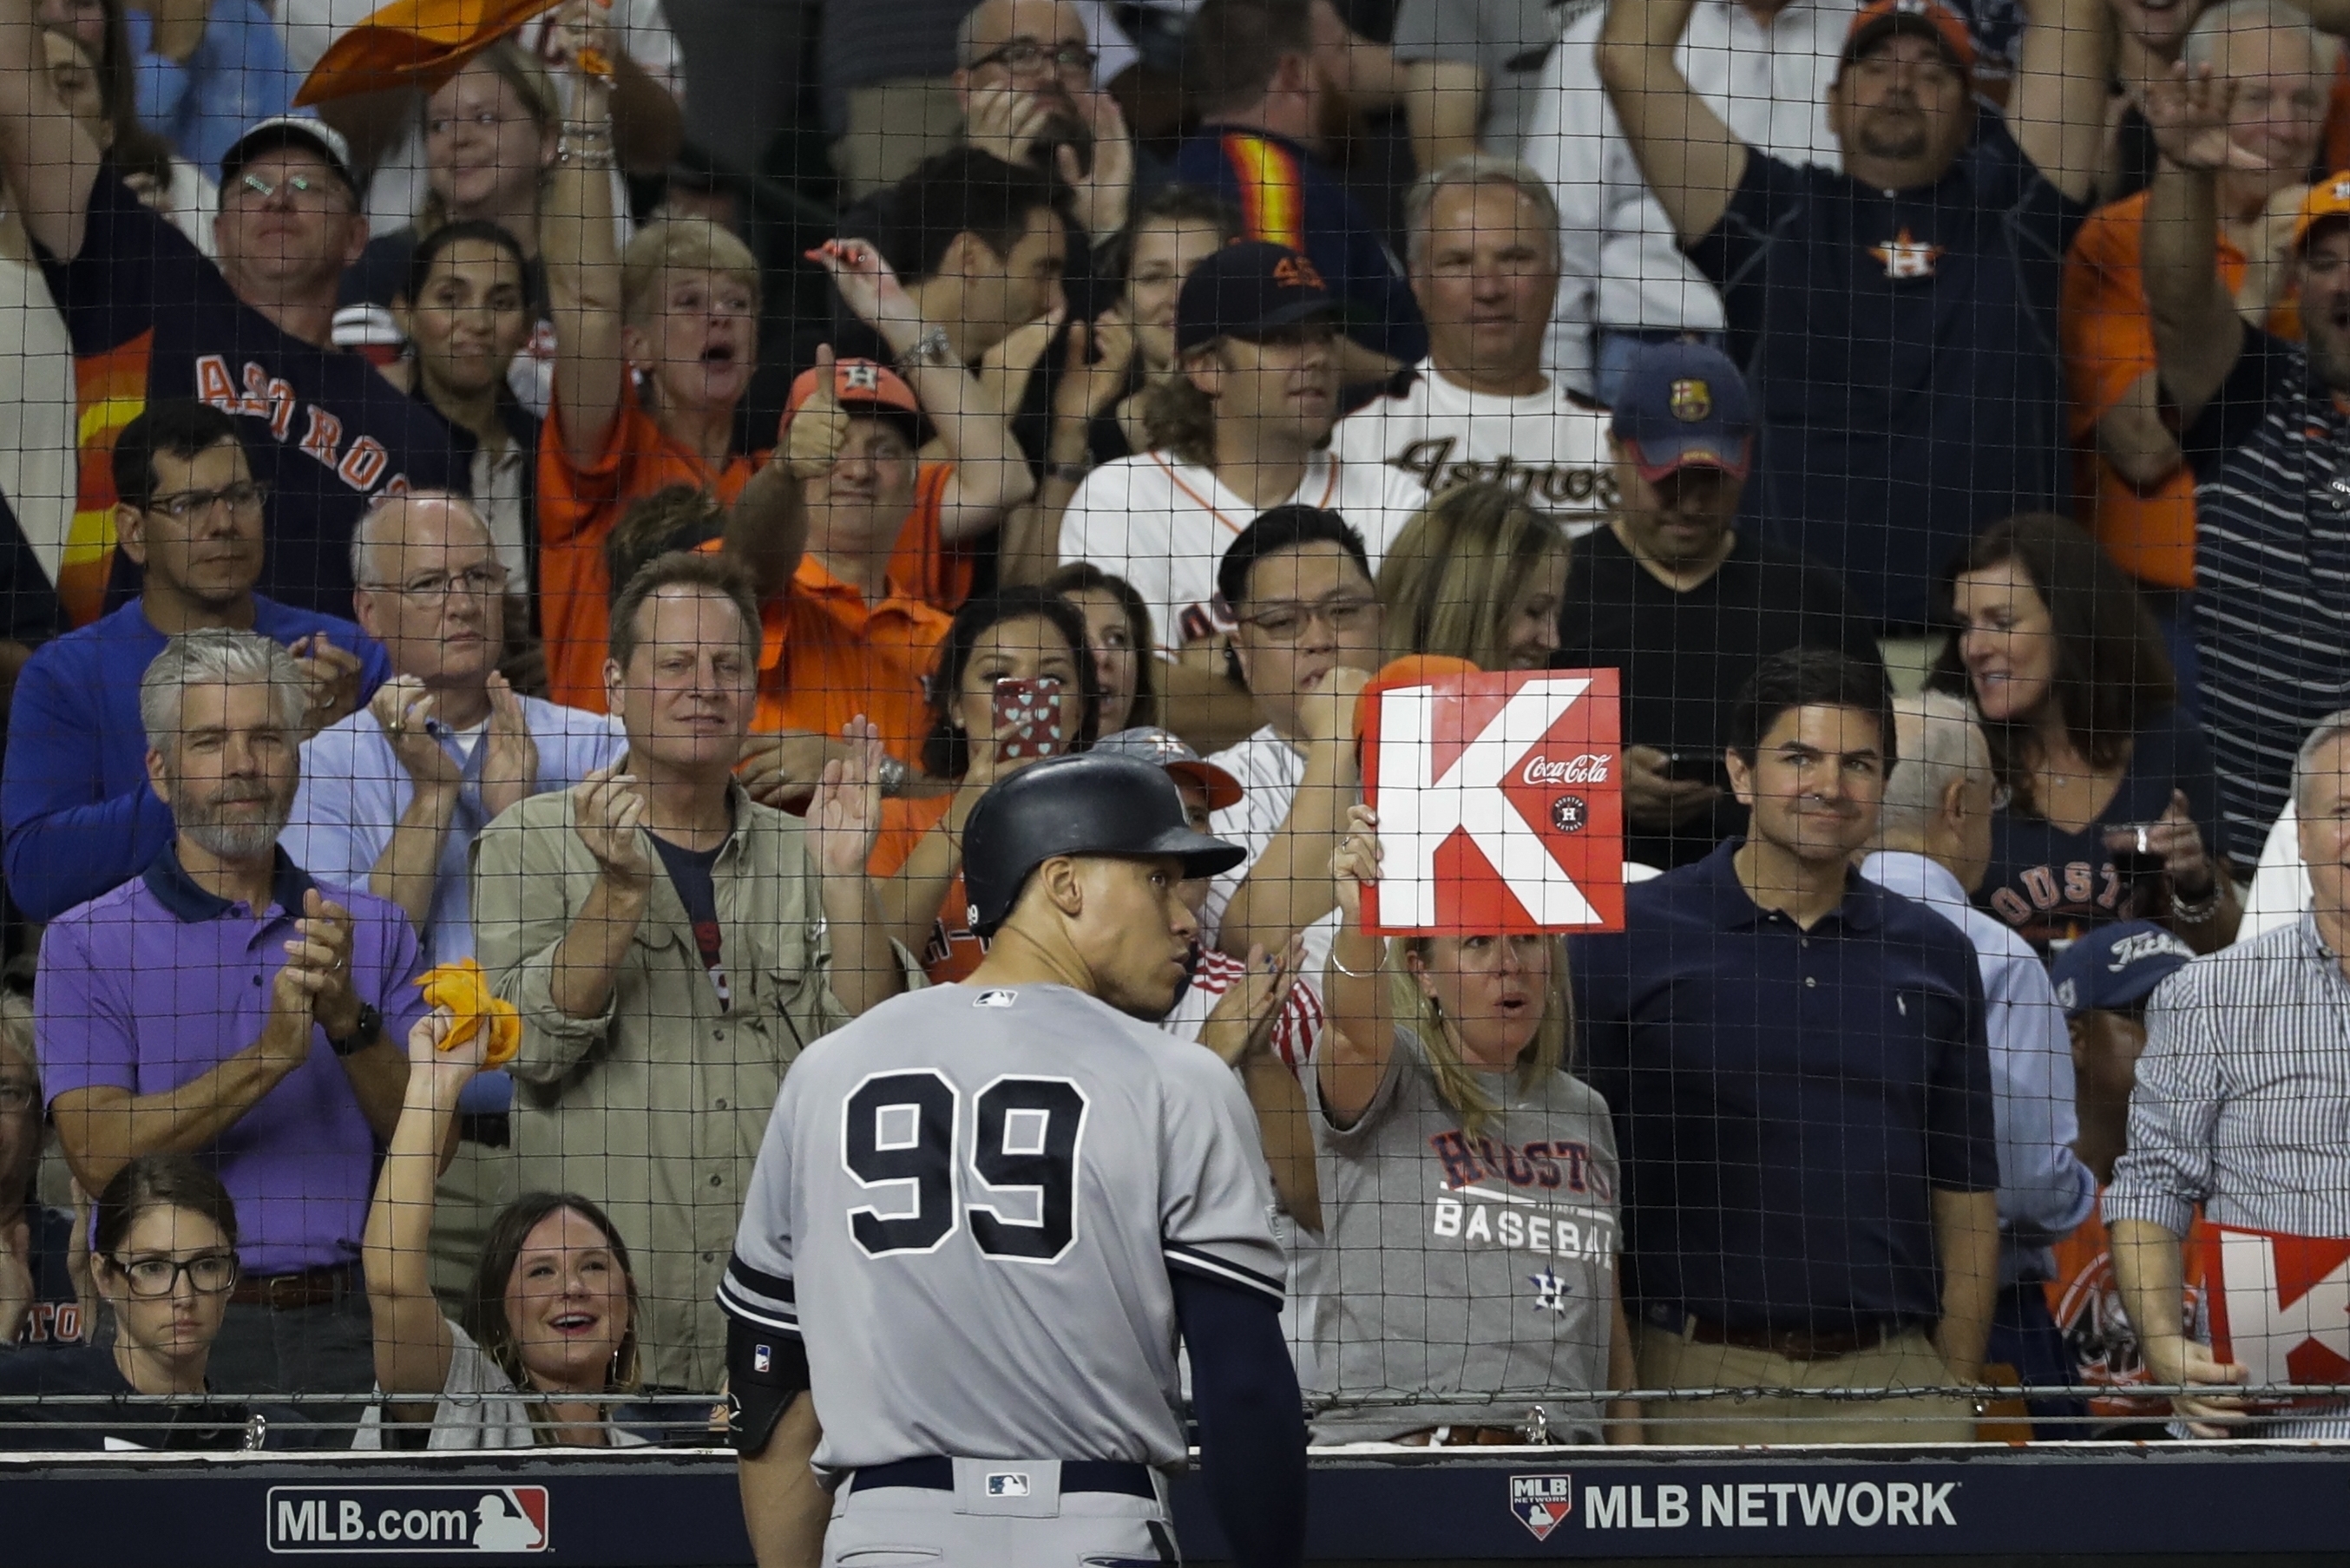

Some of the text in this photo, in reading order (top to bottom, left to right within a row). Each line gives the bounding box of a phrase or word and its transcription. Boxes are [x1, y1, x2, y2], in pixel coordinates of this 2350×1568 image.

[1523, 754, 1612, 784] Coca-Cola
[1377, 679, 1604, 928] K
[1562, 808, 1576, 821] H
[840, 1067, 1091, 1265] 99
[1535, 1273, 1566, 1309] H
[18, 1302, 82, 1343] TO
[1513, 1478, 1567, 1497] MLB
[1513, 1495, 1567, 1504] NETWORK
[1585, 1481, 1957, 1529] MLB NETWORK
[278, 1500, 468, 1541] MLB.com
